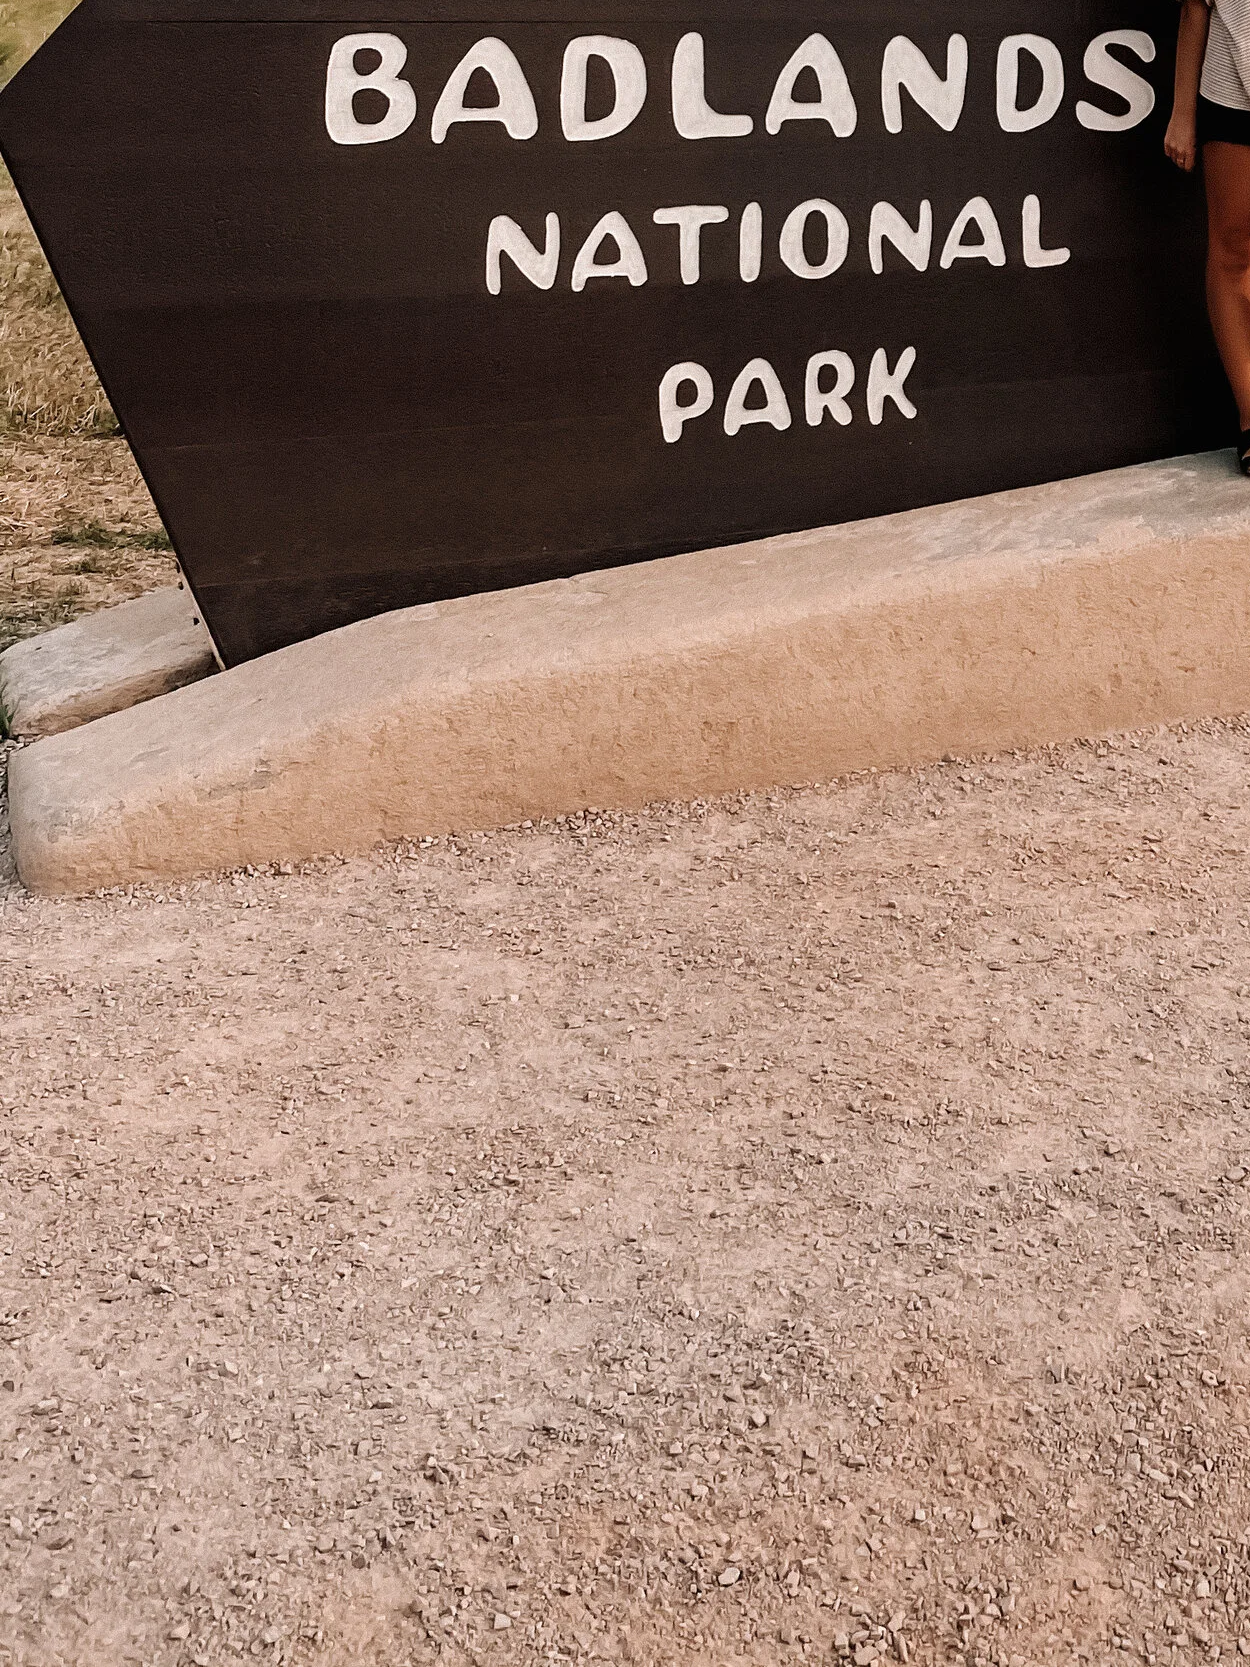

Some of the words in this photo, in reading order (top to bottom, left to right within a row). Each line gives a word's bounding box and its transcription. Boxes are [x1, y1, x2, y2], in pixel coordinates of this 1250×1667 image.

[324, 29, 1157, 145] BADLANDS
[485, 194, 1071, 295] NATIONAL
[659, 345, 918, 443] PARK
